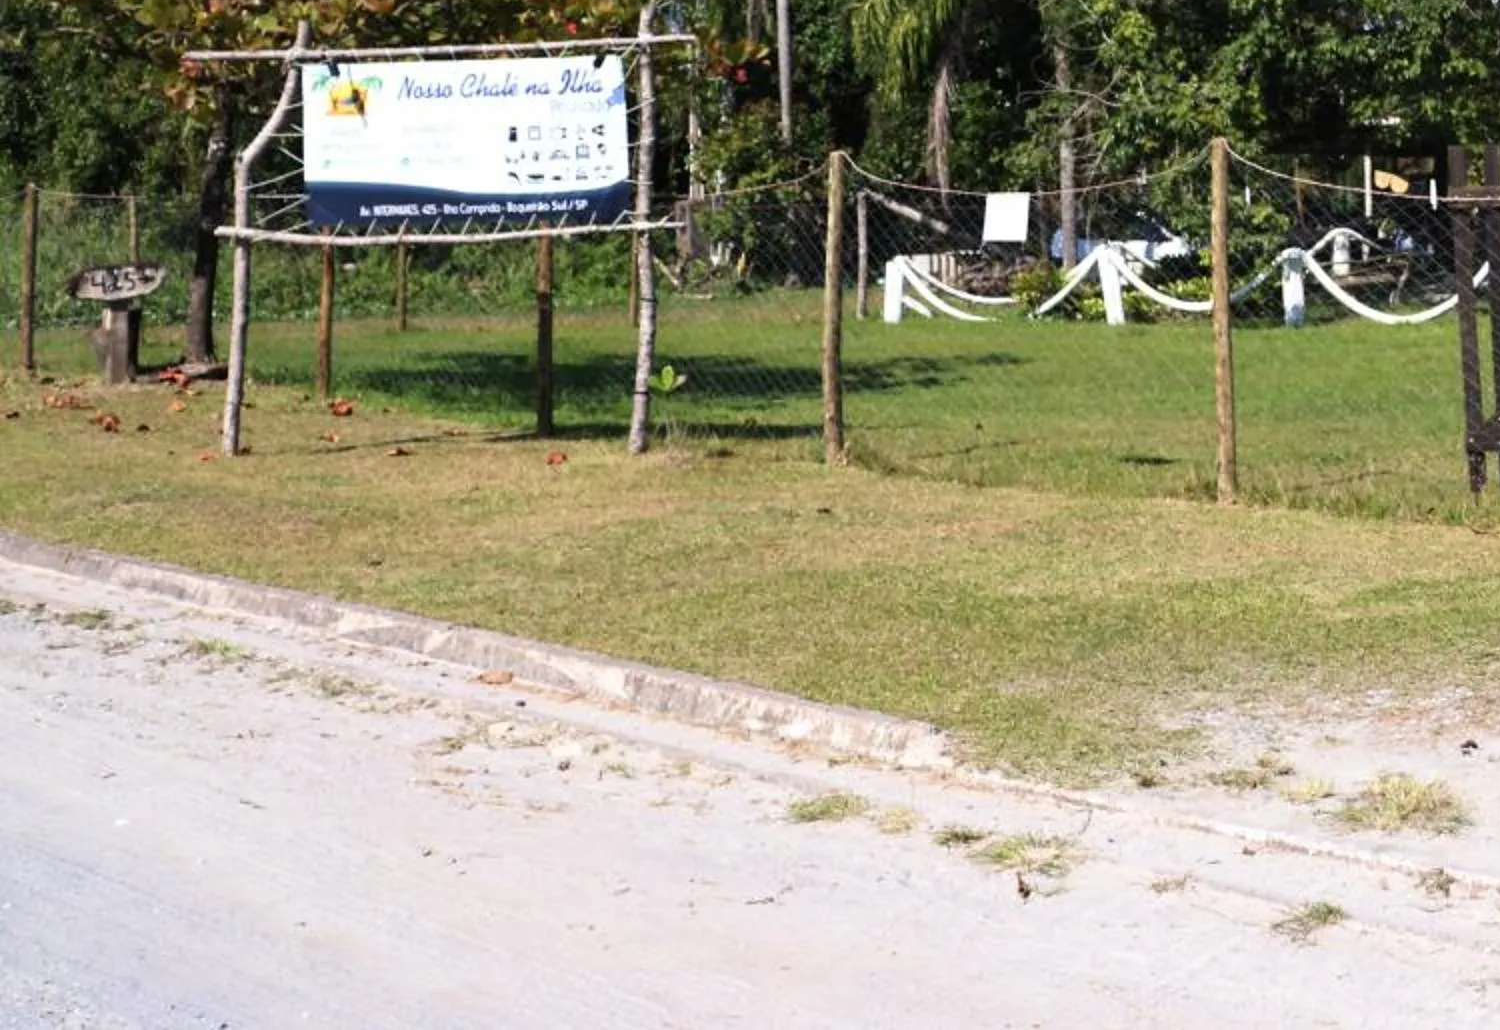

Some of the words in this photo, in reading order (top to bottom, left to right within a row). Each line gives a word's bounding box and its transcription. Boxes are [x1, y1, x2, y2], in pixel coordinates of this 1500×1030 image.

[397, 75, 452, 100] Nosso
[525, 81, 550, 95] na
[91, 271, 137, 295] 425
